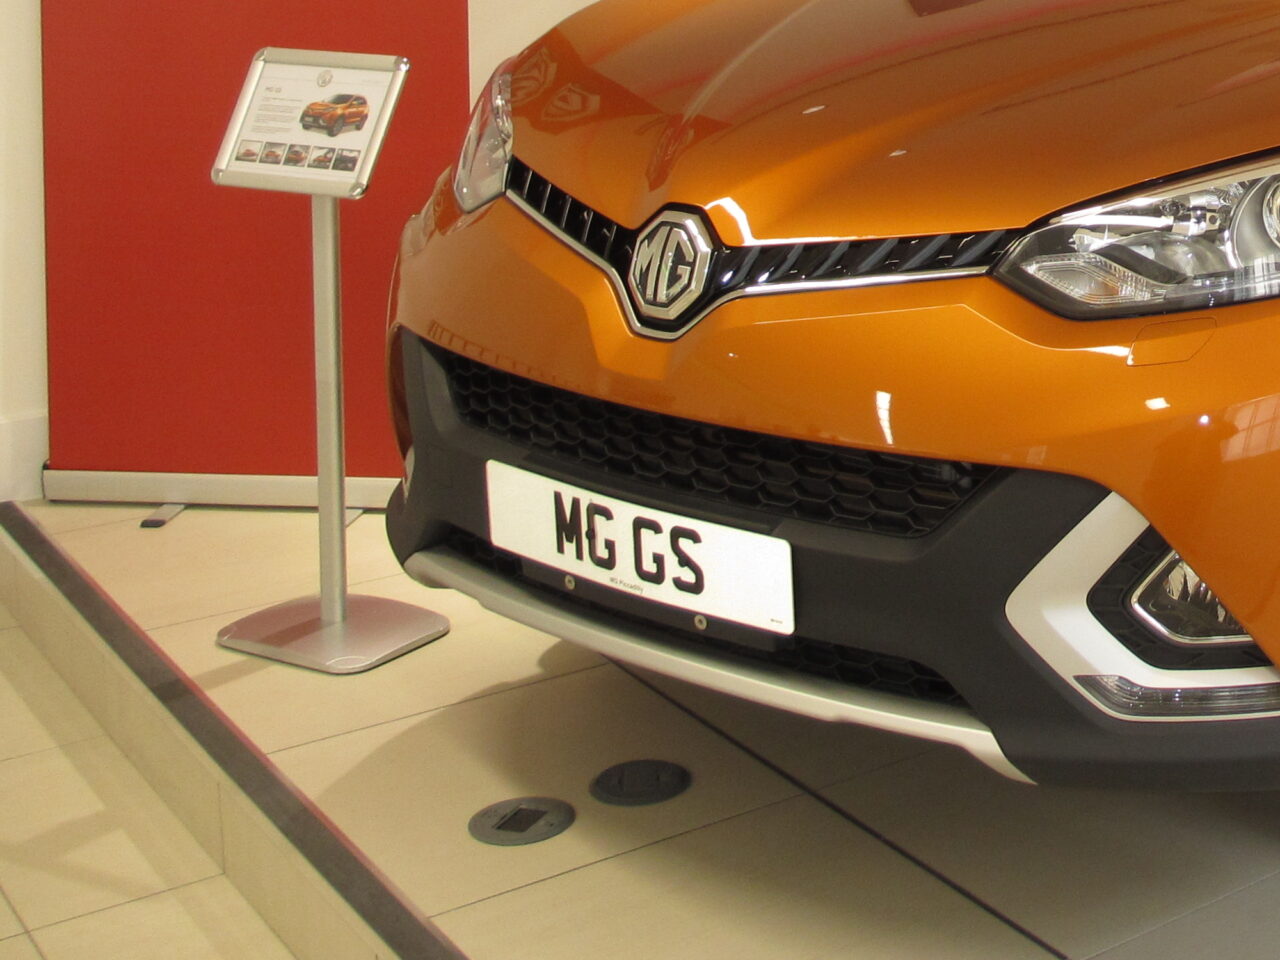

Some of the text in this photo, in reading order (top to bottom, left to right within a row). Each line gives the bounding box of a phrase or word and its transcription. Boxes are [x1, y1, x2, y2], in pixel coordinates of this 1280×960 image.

[635, 225, 695, 304] MG
[553, 489, 705, 596] MG GS
